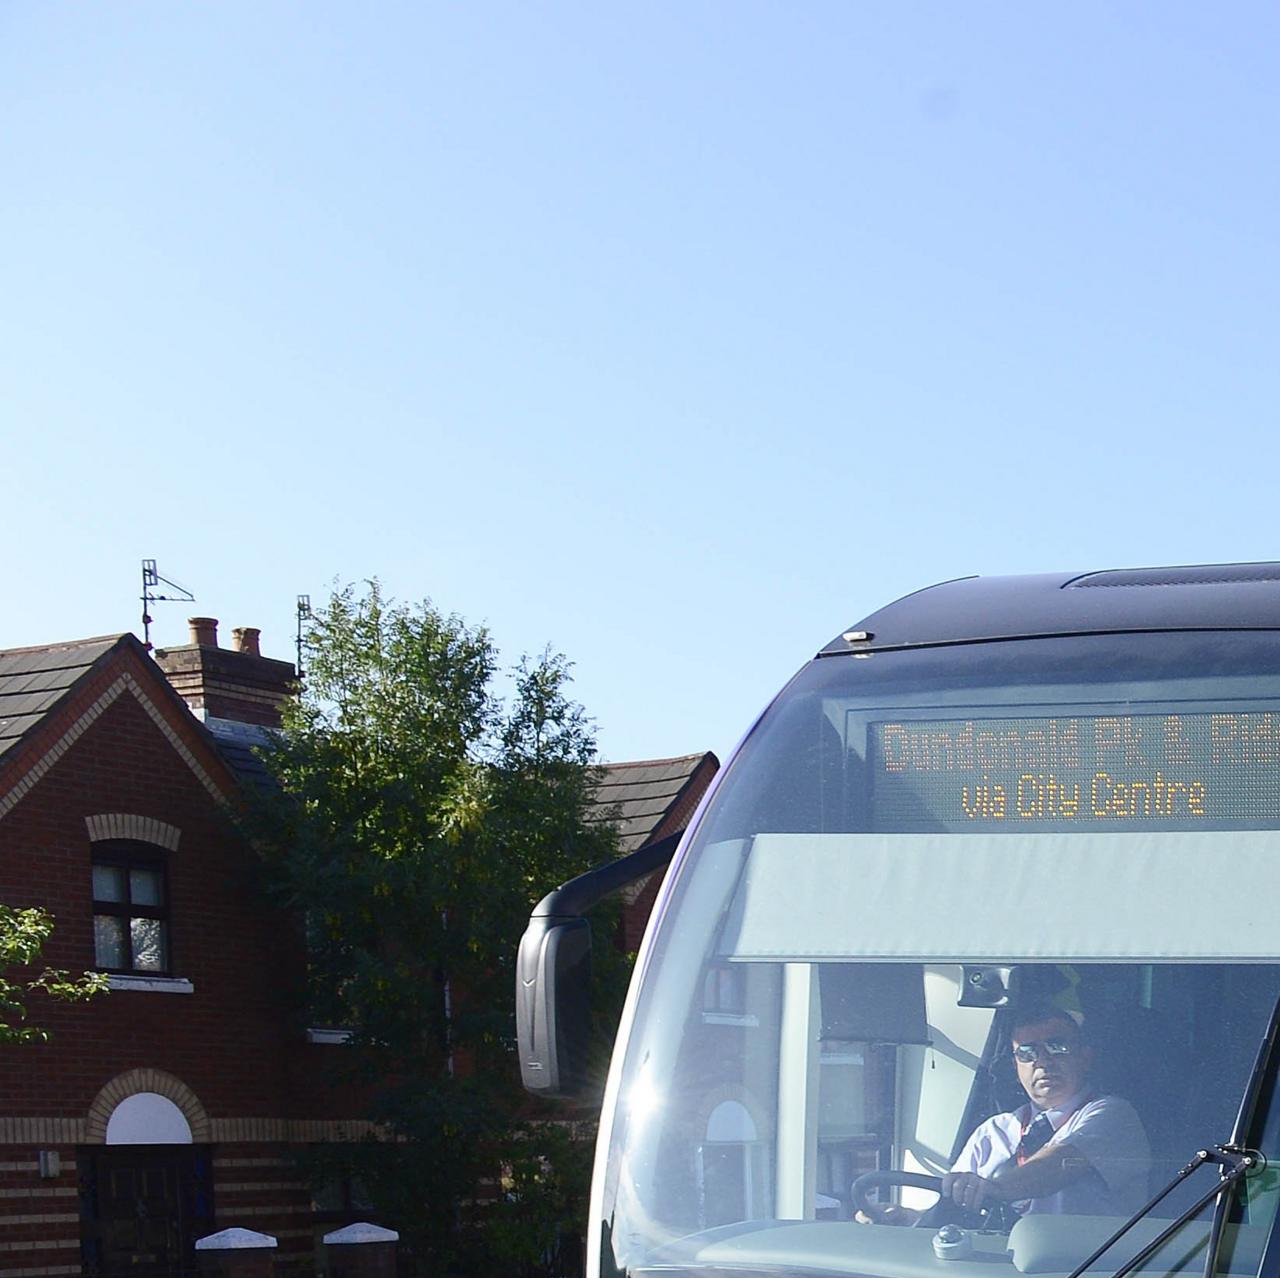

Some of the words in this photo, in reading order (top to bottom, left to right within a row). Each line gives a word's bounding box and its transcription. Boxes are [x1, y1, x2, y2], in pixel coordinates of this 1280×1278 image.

[884, 719, 1078, 771] Dundonald
[1095, 717, 1147, 766] Pk
[962, 774, 1005, 818] via
[1017, 773, 1080, 817] City
[1091, 771, 1205, 817] Centre
